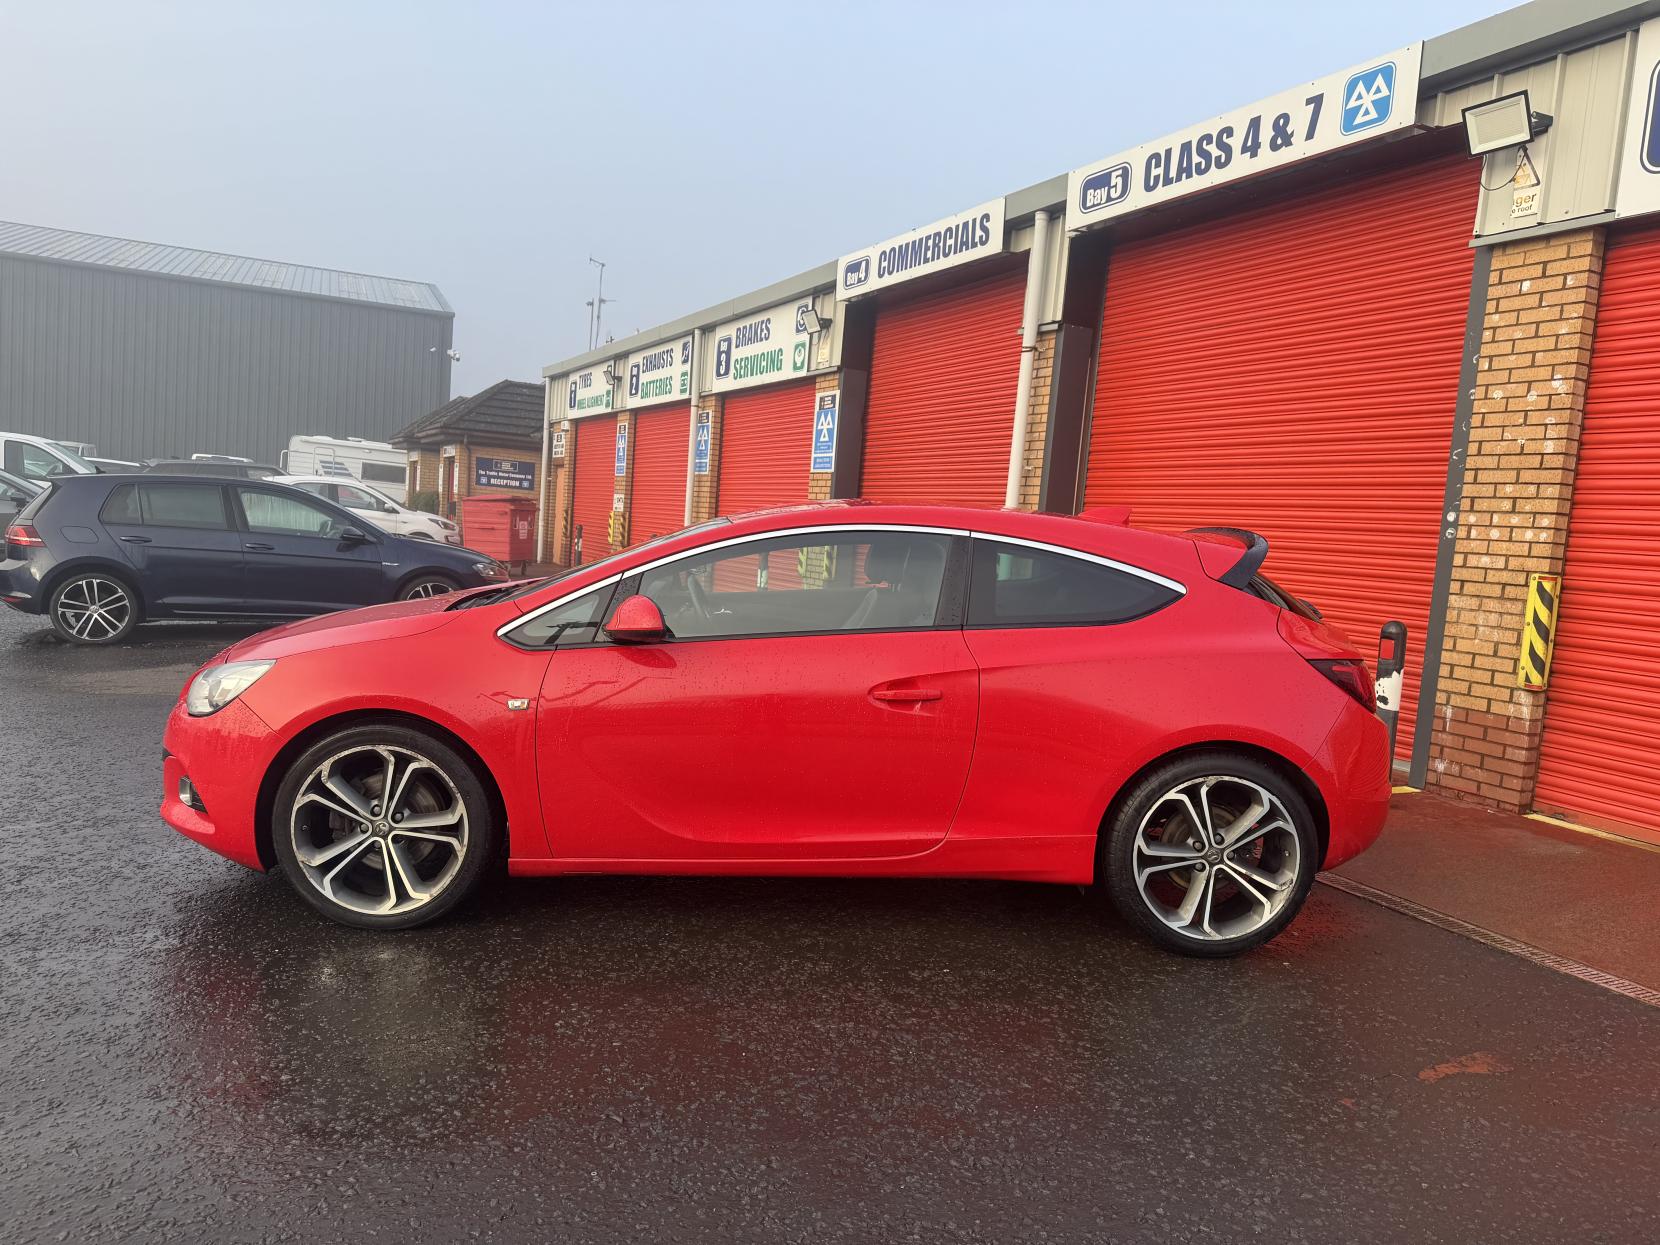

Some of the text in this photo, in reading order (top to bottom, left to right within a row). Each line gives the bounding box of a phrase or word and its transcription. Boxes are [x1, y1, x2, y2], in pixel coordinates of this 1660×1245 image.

[1143, 93, 1325, 193] CLASS 4 & 7
[1086, 169, 1123, 207] Bay 5
[877, 212, 991, 279] COMMERCIALS
[846, 260, 867, 286] Bay 4
[735, 318, 771, 349] BRAKES
[642, 347, 674, 374] EXHAUSTS
[719, 352, 727, 375] 3
[733, 347, 783, 380] SERVICING
[578, 371, 593, 390] TYRES
[631, 375, 638, 395] 2
[640, 375, 673, 400] BATTERIES
[490, 478, 520, 487] RECEPTION
